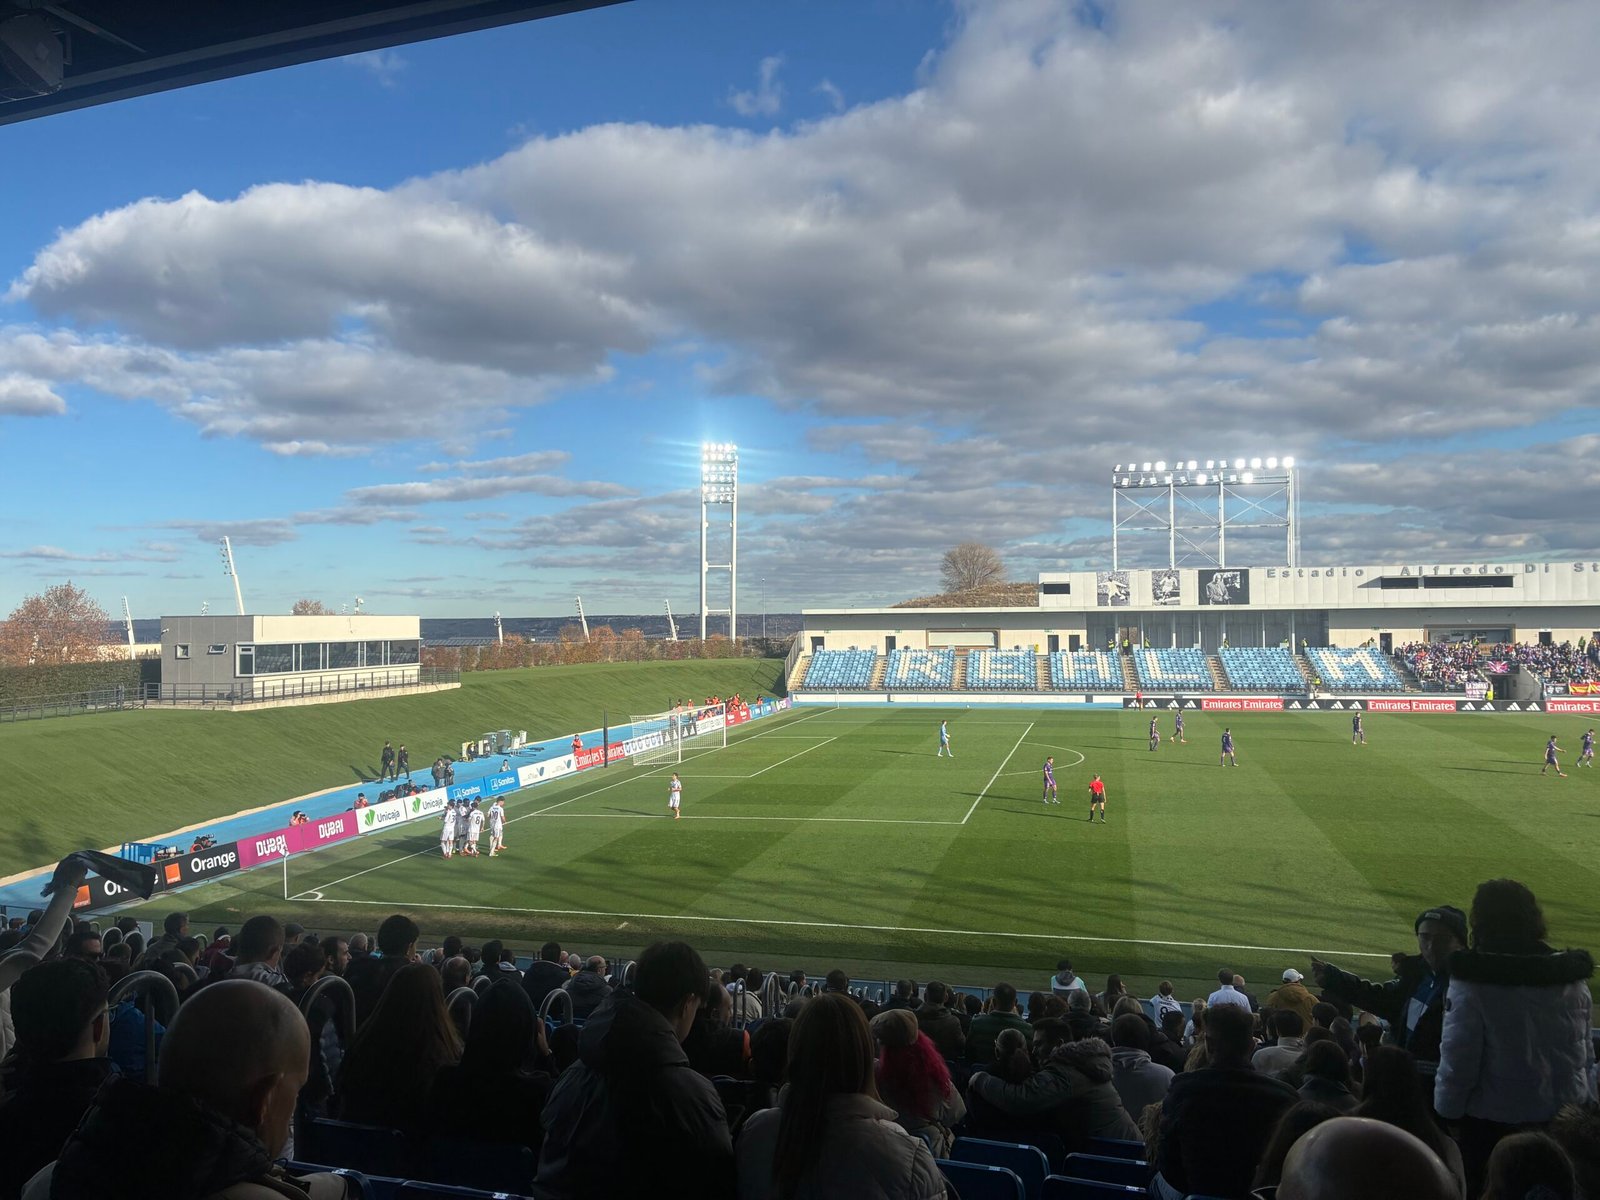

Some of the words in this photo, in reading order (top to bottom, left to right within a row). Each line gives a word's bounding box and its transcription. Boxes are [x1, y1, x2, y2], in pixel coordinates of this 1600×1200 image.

[1267, 567, 1364, 578] Estadio
[1400, 565, 1504, 577] Alfredo
[1525, 563, 1549, 574] Di
[1203, 700, 1241, 709] Emirates
[1243, 700, 1283, 709] Emirates
[1369, 701, 1410, 710] Emirates
[1412, 701, 1454, 711] Emirates
[1546, 702, 1591, 711] Emirates
[422, 798, 443, 810] Unicaja
[376, 810, 401, 823] Unicaja
[318, 819, 344, 839] DUBAI
[191, 851, 237, 873] Orange
